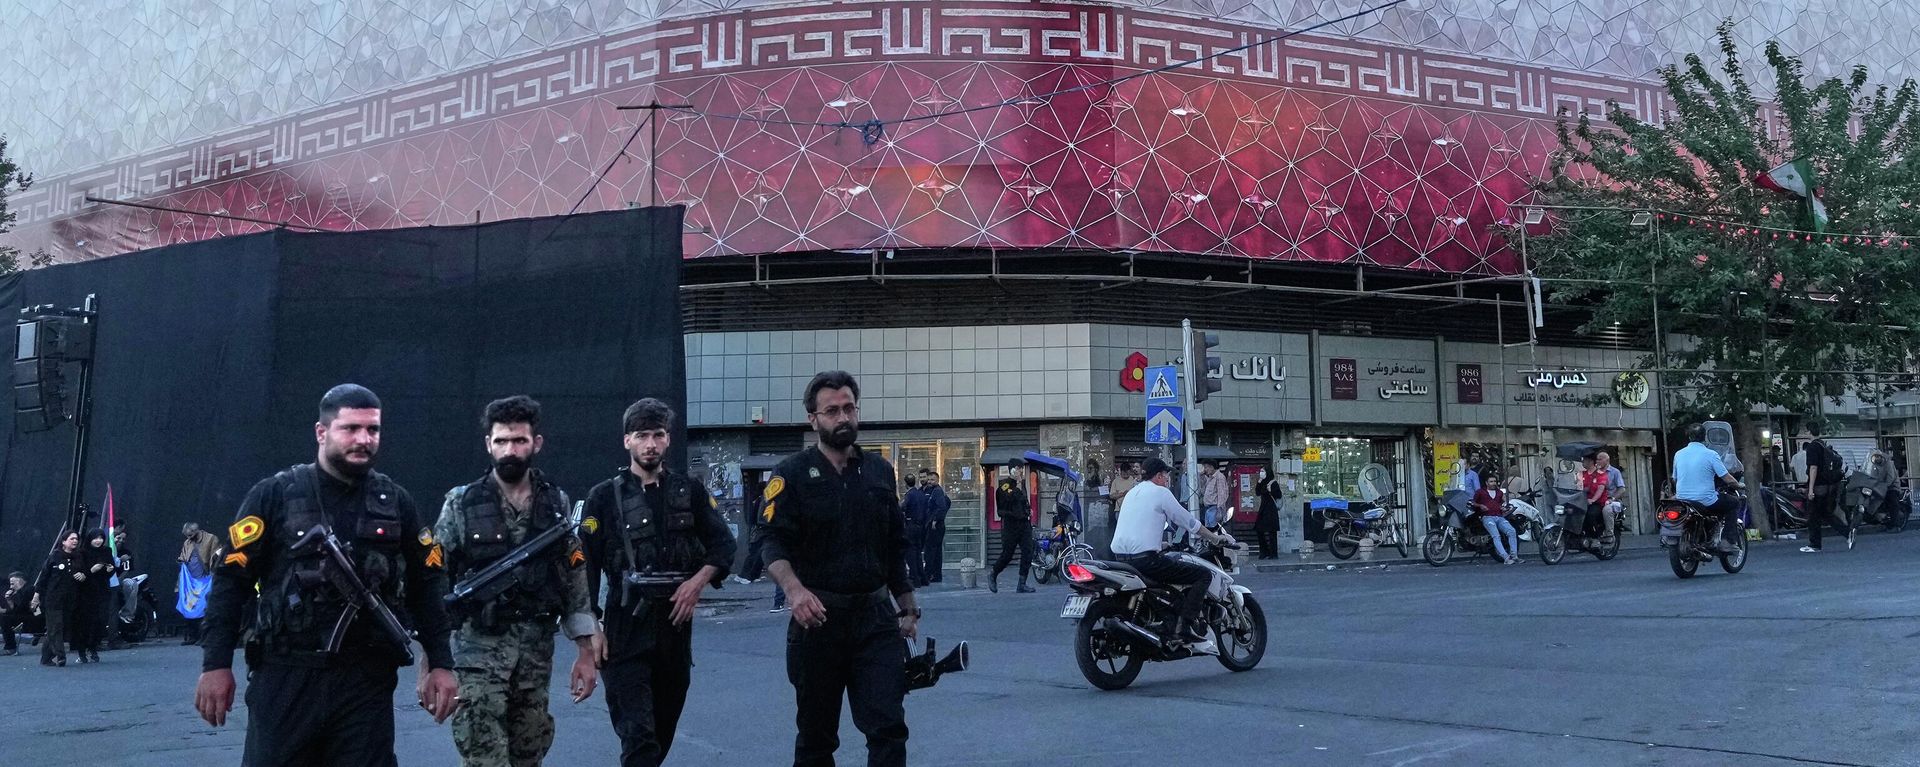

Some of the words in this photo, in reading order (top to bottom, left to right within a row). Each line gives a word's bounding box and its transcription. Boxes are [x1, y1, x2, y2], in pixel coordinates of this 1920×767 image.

[1334, 363, 1354, 372] 984
[1460, 368, 1479, 377] 986
[1379, 379, 1428, 399] ساعتی
